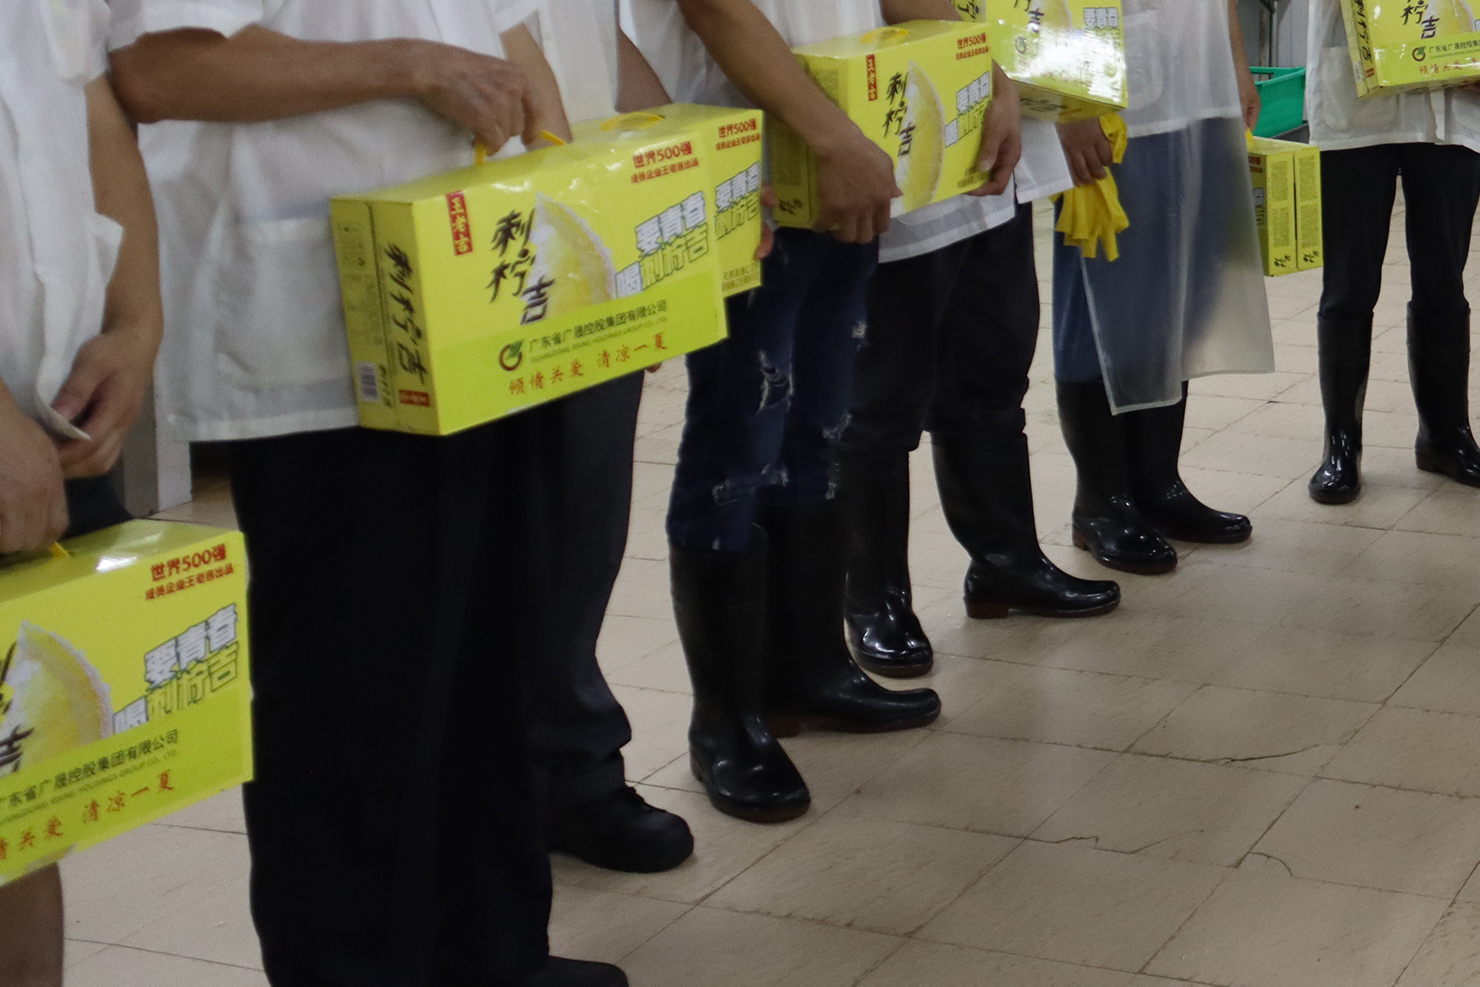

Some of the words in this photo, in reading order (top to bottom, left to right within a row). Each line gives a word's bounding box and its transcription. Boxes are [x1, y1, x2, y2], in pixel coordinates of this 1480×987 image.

[633, 141, 692, 169] 世界500强
[449, 194, 472, 254] 王老吉
[485, 208, 555, 325] 刺柠吉
[598, 331, 667, 368] 清凉一夏
[151, 543, 227, 582] 世界500强
[82, 769, 174, 824] 清凉一夏
